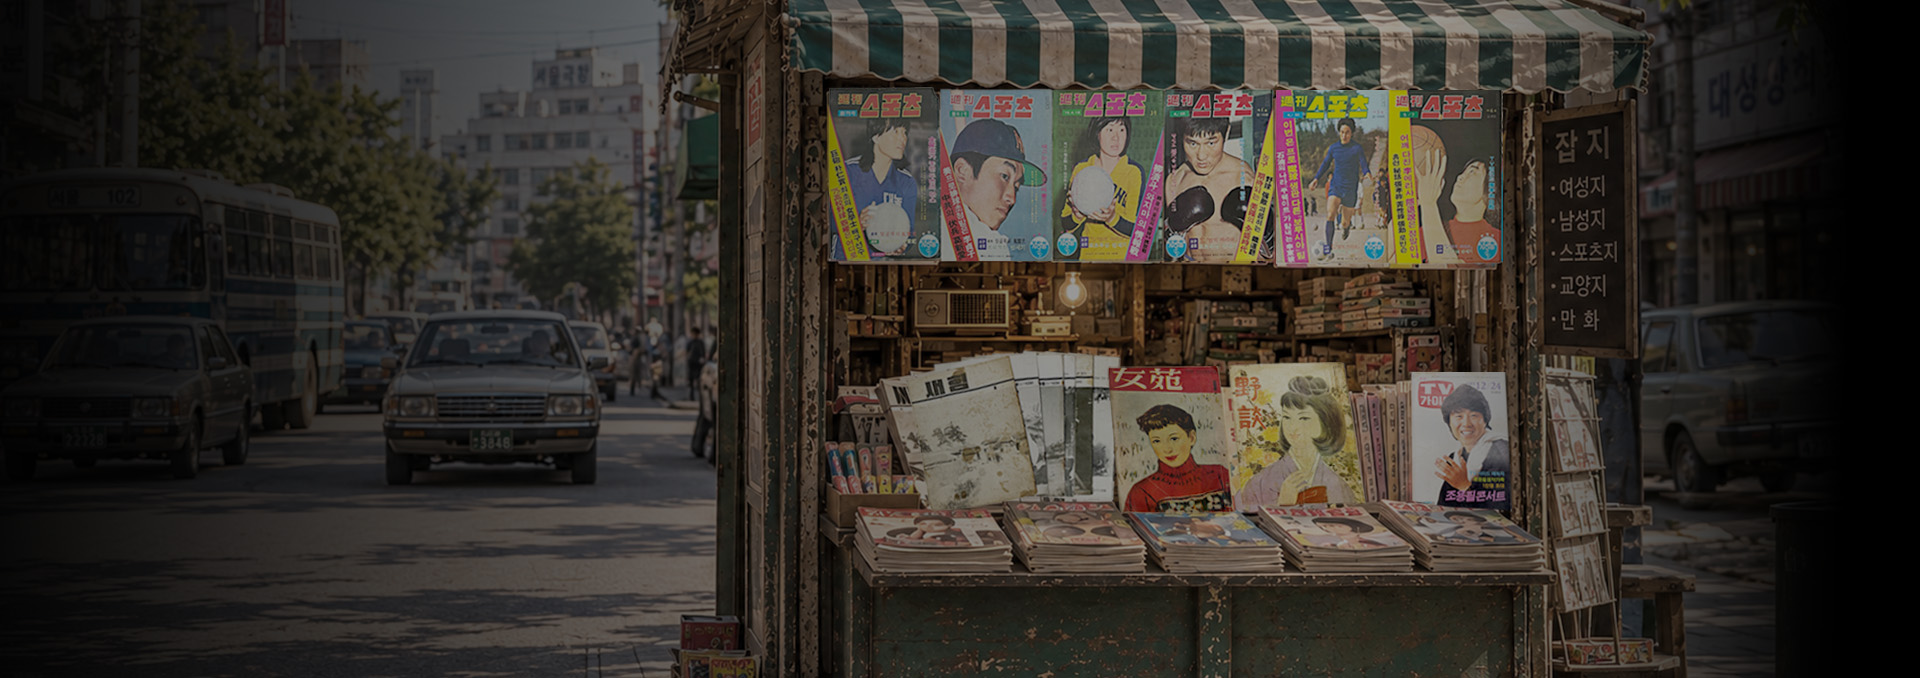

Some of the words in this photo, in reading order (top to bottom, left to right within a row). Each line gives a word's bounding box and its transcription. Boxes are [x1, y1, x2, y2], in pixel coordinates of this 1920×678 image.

[859, 92, 922, 118] 스포츠
[972, 95, 1034, 118] 스포츠
[1059, 93, 1086, 105] 週刊
[1084, 92, 1147, 117] 스포츠
[1167, 94, 1194, 106] 週刊
[1191, 93, 1253, 118] 스포츠
[1280, 95, 1307, 107] 週刊
[1305, 95, 1369, 119] 스포츠
[1395, 95, 1423, 107] 週刊
[1420, 95, 1483, 119] 스포츠
[107, 188, 136, 205] 102
[1559, 175, 1606, 199] 여성지
[1559, 208, 1606, 231] 남성지
[1559, 241, 1618, 263] 스포츠지
[1560, 274, 1606, 297] 교양지
[1112, 368, 1183, 391] 女苑
[1420, 383, 1453, 394] TV
[1234, 376, 1266, 430] 野談
